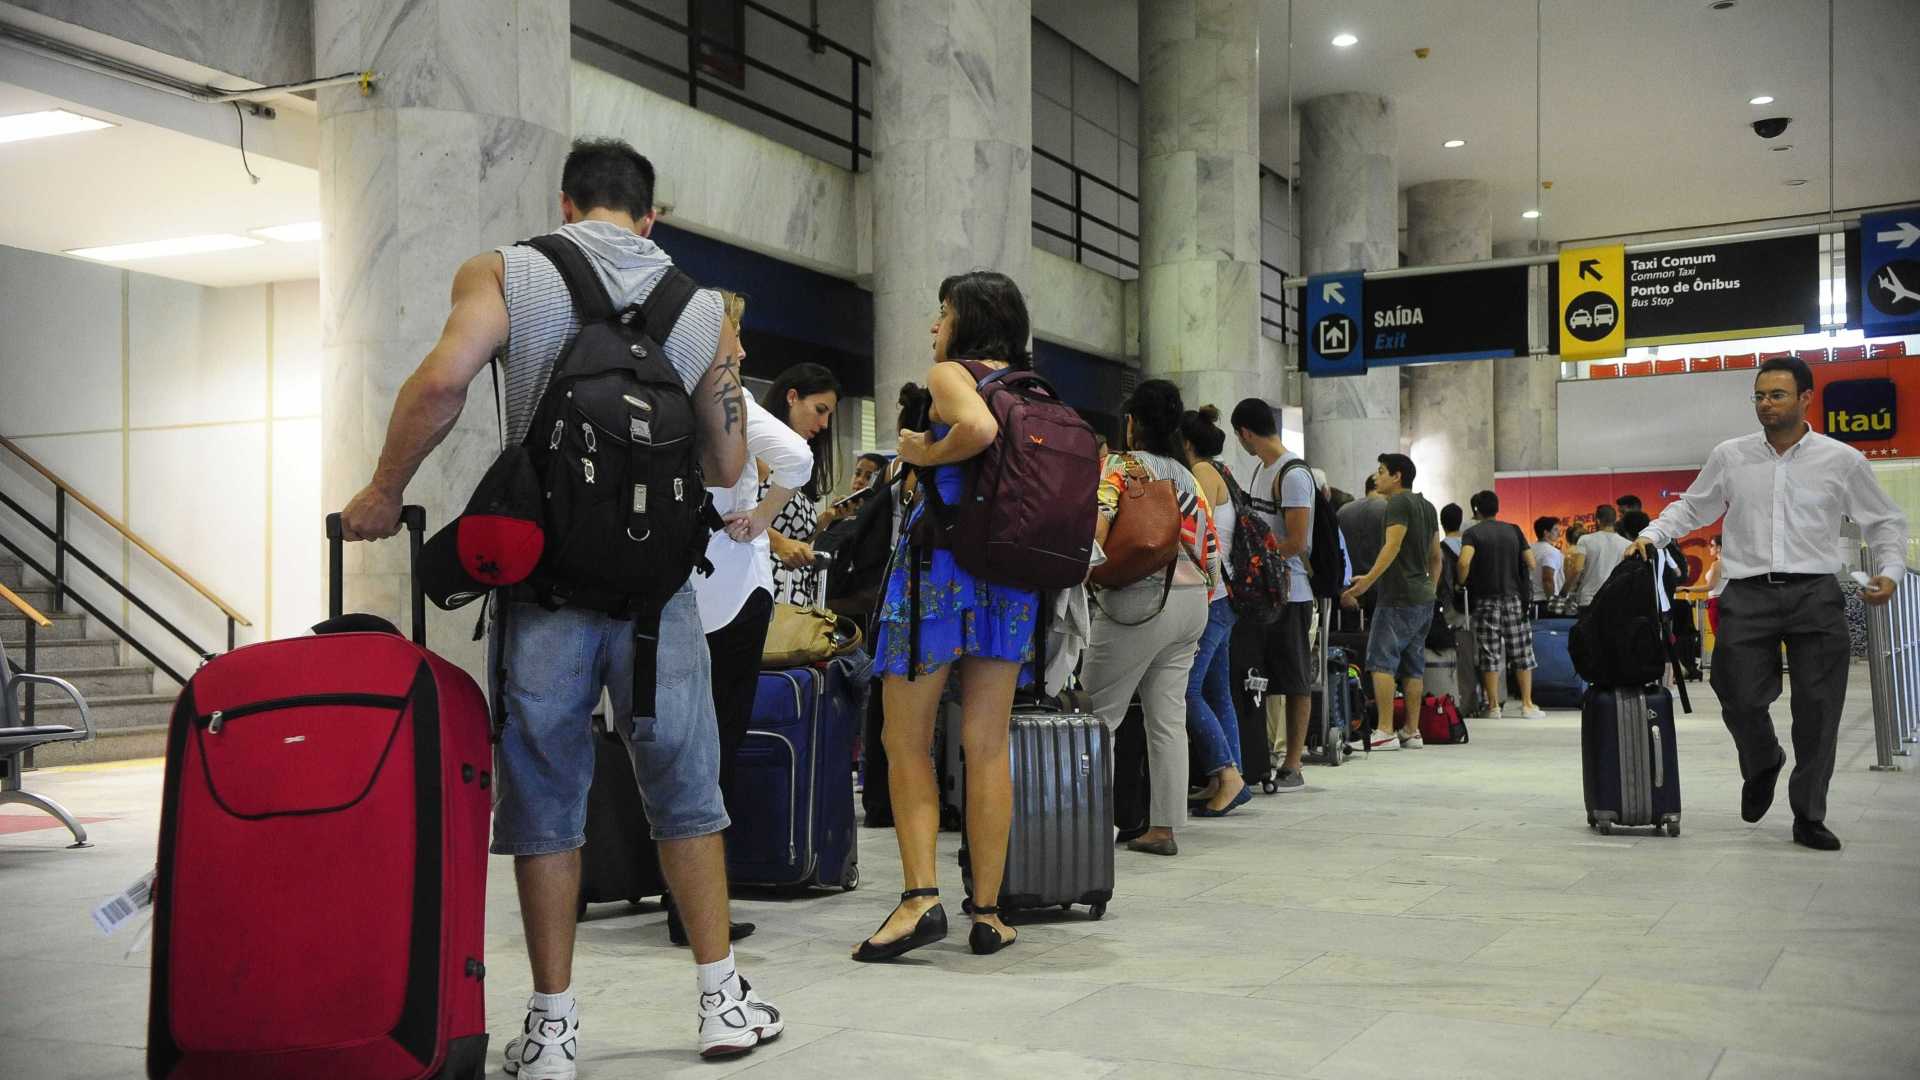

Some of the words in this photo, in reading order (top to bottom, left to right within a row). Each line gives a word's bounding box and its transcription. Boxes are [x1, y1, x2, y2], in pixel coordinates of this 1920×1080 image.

[1631, 257, 1658, 271] Taxi
[1661, 253, 1716, 267] Comum
[1630, 270, 1675, 282] Common
[1678, 265, 1697, 277] Taxi
[1630, 284, 1670, 297] Ponto
[1672, 281, 1690, 293] de
[1693, 277, 1741, 291] Ônibus
[1631, 298, 1649, 308] Bus
[1651, 296, 1675, 307] Stop
[1374, 305, 1424, 328] SAÍDA
[1375, 333, 1408, 350] Exit
[1828, 408, 1891, 433] Itaú
